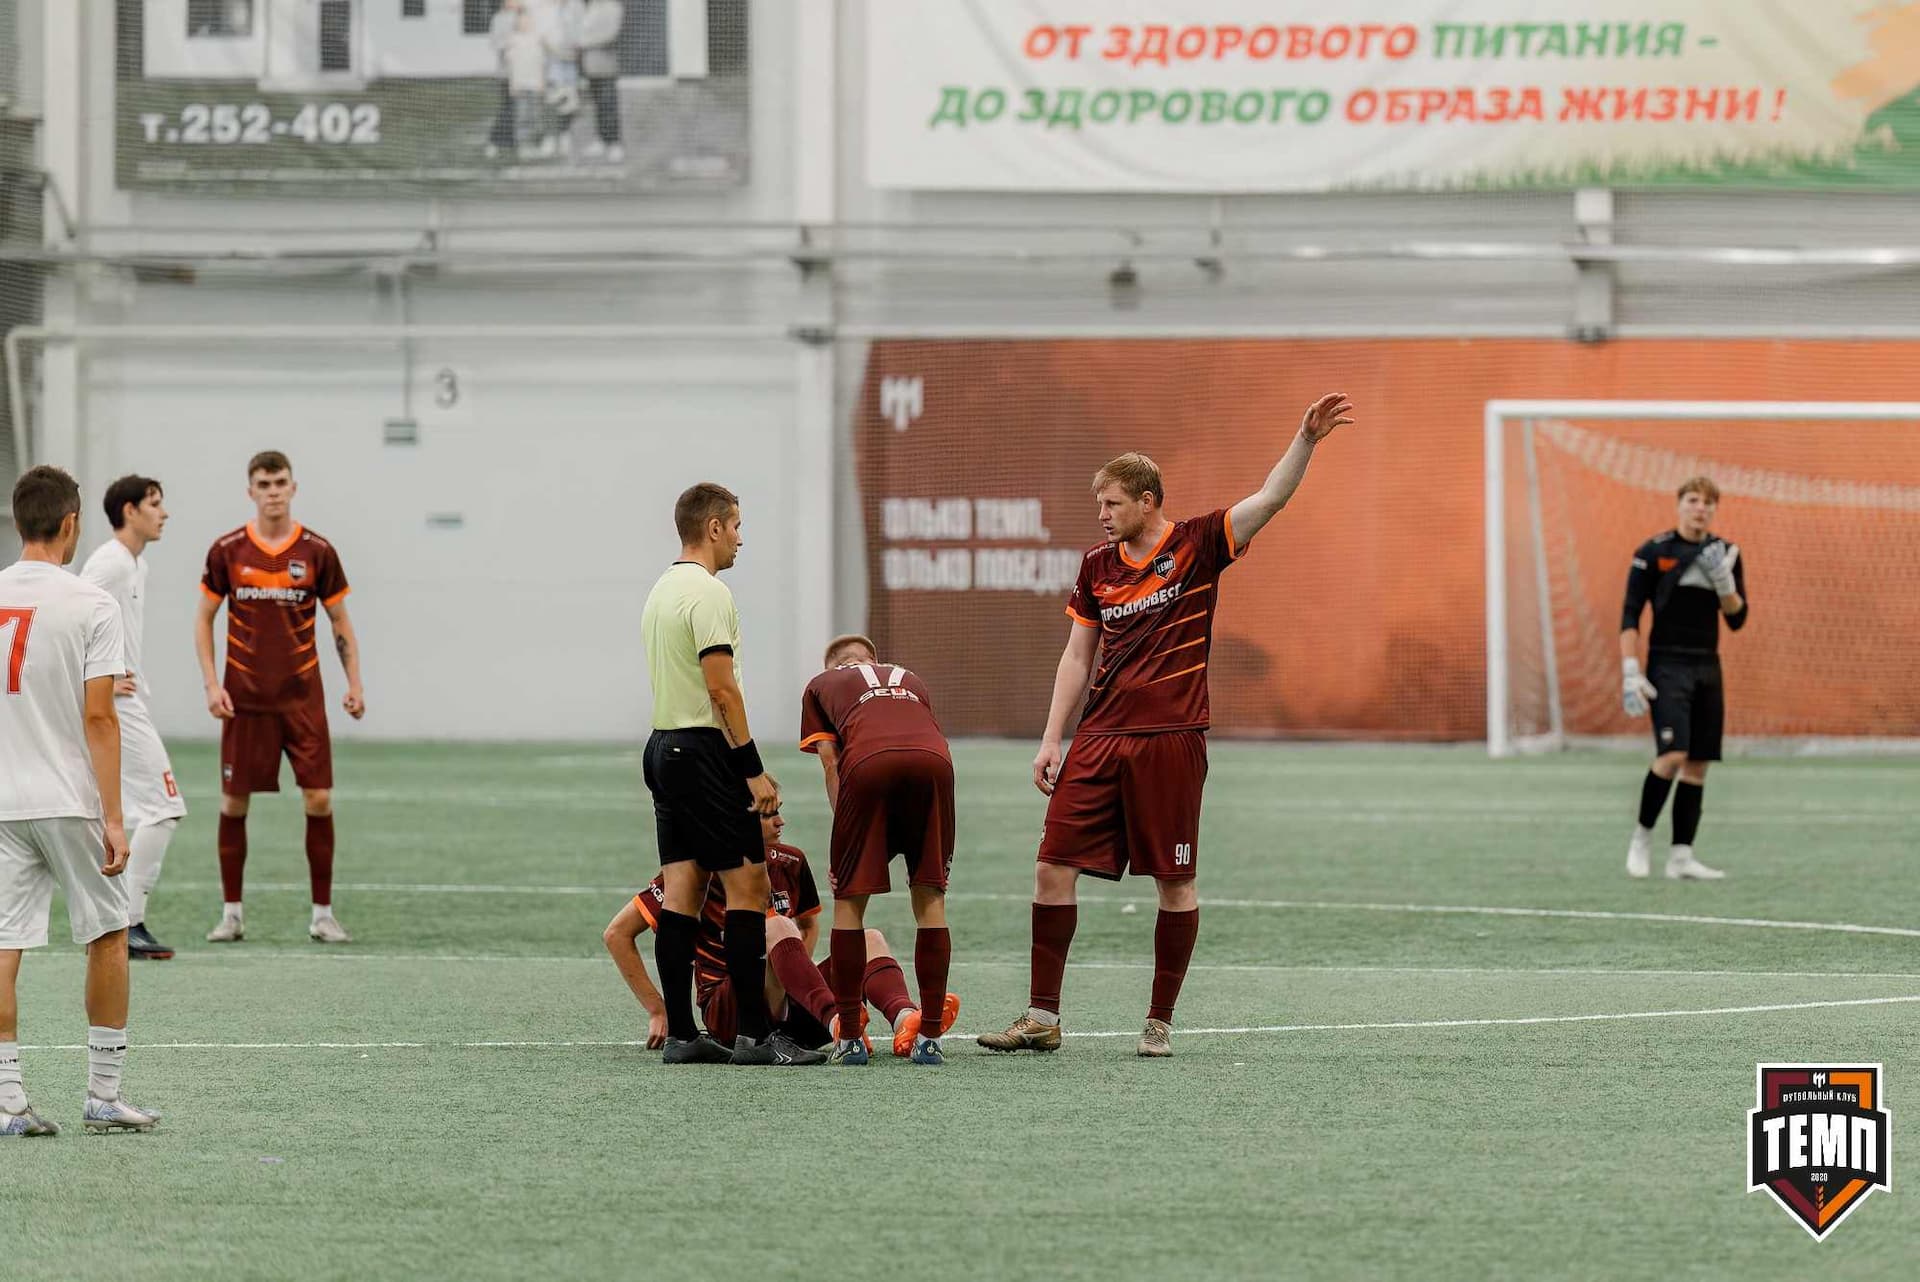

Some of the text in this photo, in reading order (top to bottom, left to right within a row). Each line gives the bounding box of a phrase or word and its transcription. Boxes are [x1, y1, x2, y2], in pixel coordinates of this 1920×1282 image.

[1023, 24, 1091, 60] ОТ
[1101, 24, 1418, 67] ЗДОРОВОГО
[1433, 23, 1686, 59] ПИТАНИЯ
[140, 103, 381, 144] т.252-402
[930, 87, 1006, 127] ДО
[1017, 88, 1331, 129] ЗДОРОВОГО
[1345, 88, 1544, 122] ОБРАЗА
[435, 366, 460, 411] 3
[1101, 583, 1182, 622] ПРОДИНВЕСТ
[162, 771, 178, 798] 6
[1175, 843, 1191, 866] 90
